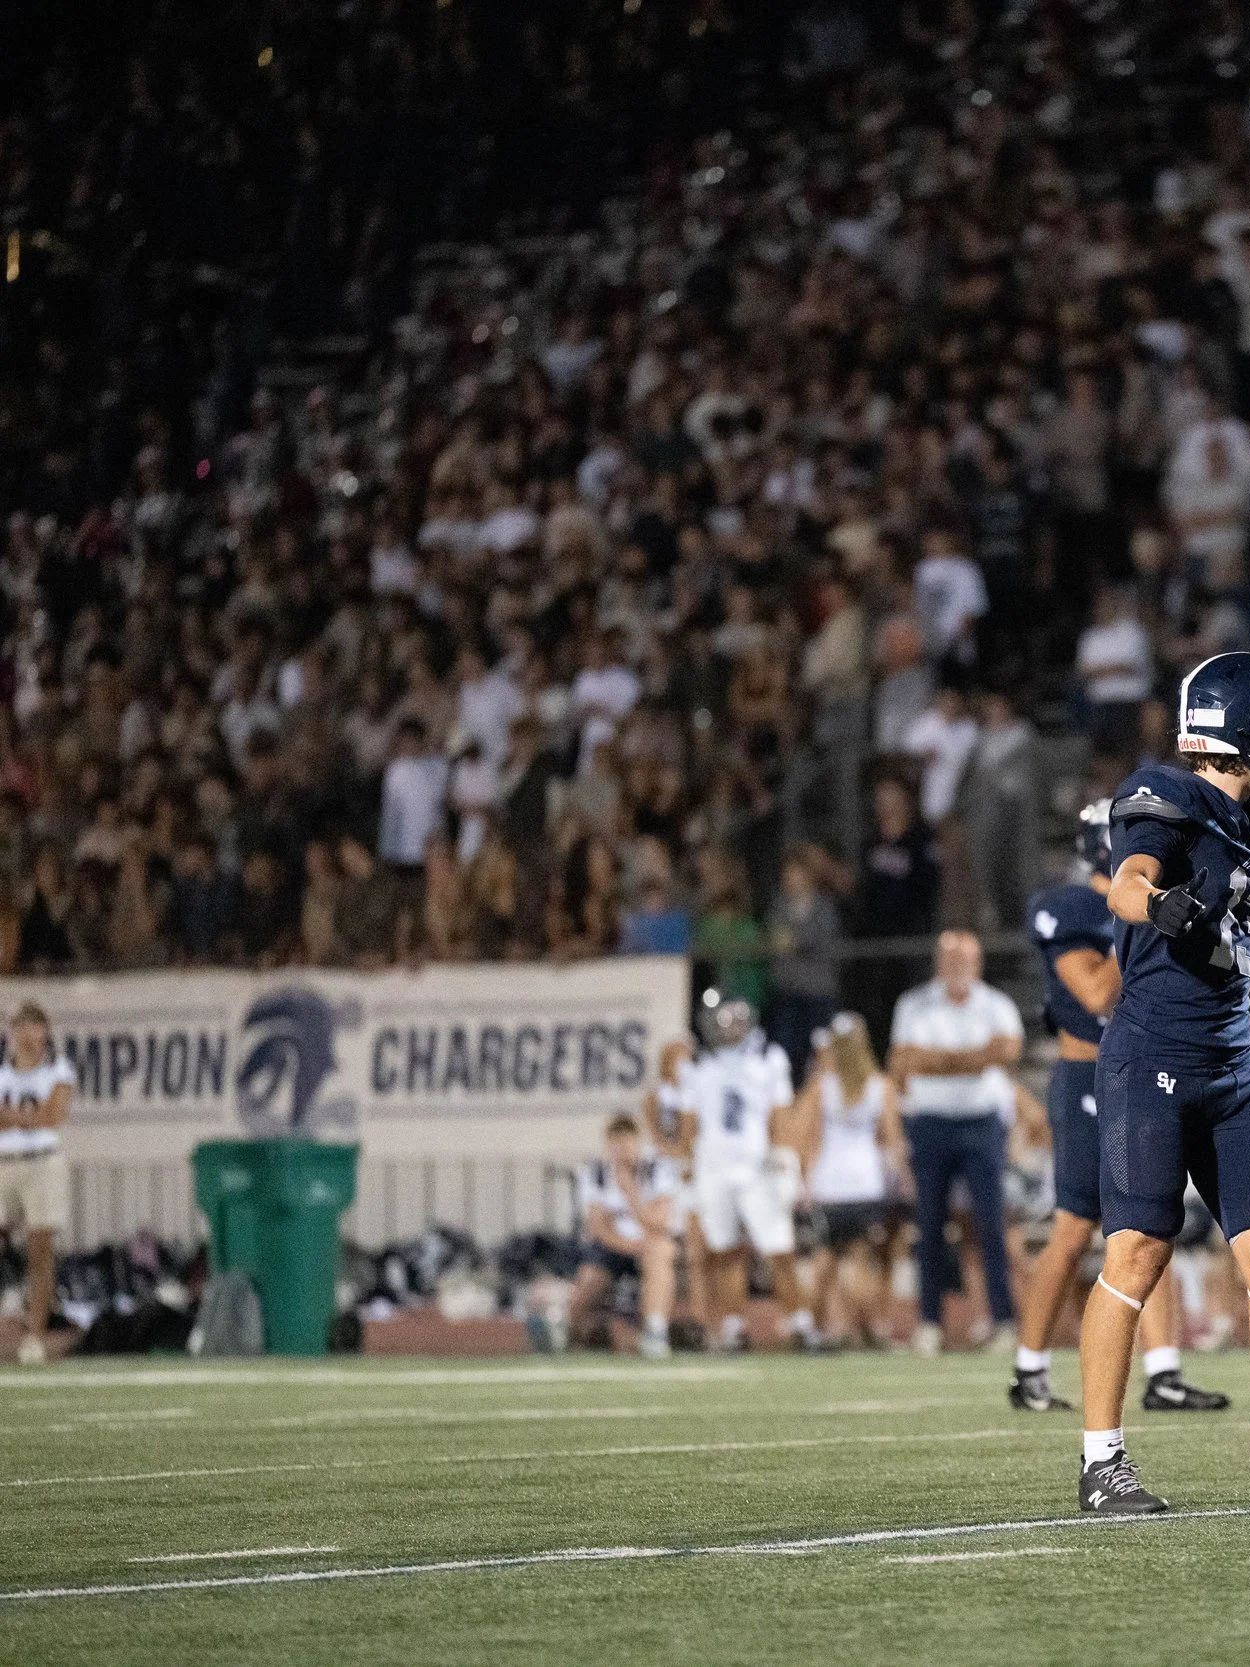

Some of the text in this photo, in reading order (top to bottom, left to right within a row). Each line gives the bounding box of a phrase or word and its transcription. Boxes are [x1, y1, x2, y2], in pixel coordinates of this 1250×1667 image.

[0, 1020, 647, 1099] MPION CHARGERS
[1157, 1071, 1177, 1094] SV
